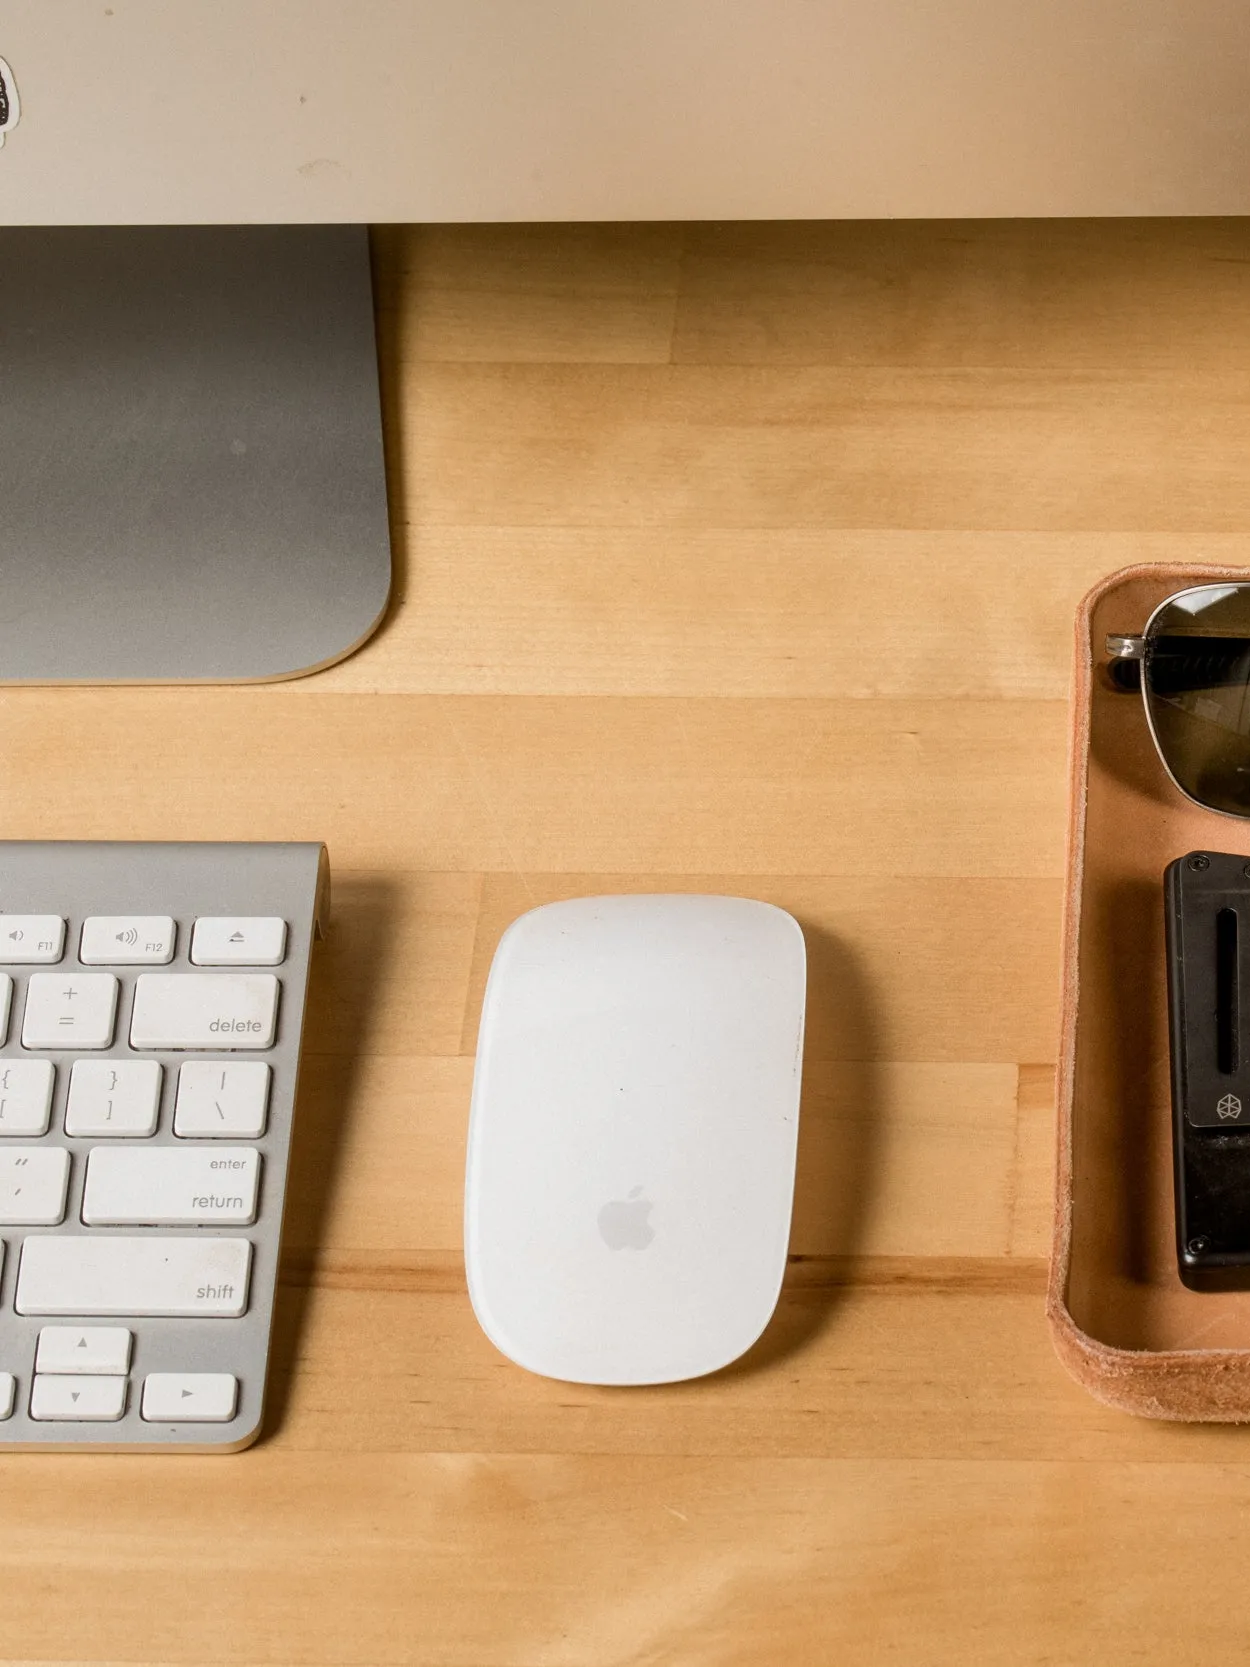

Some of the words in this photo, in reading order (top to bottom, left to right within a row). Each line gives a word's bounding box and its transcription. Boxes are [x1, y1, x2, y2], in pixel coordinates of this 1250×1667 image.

[38, 942, 53, 951] F11
[145, 943, 163, 952] F12
[209, 1018, 262, 1033] delete
[209, 1159, 247, 1170] enter
[191, 1194, 243, 1208] return
[196, 1284, 235, 1299] shift
